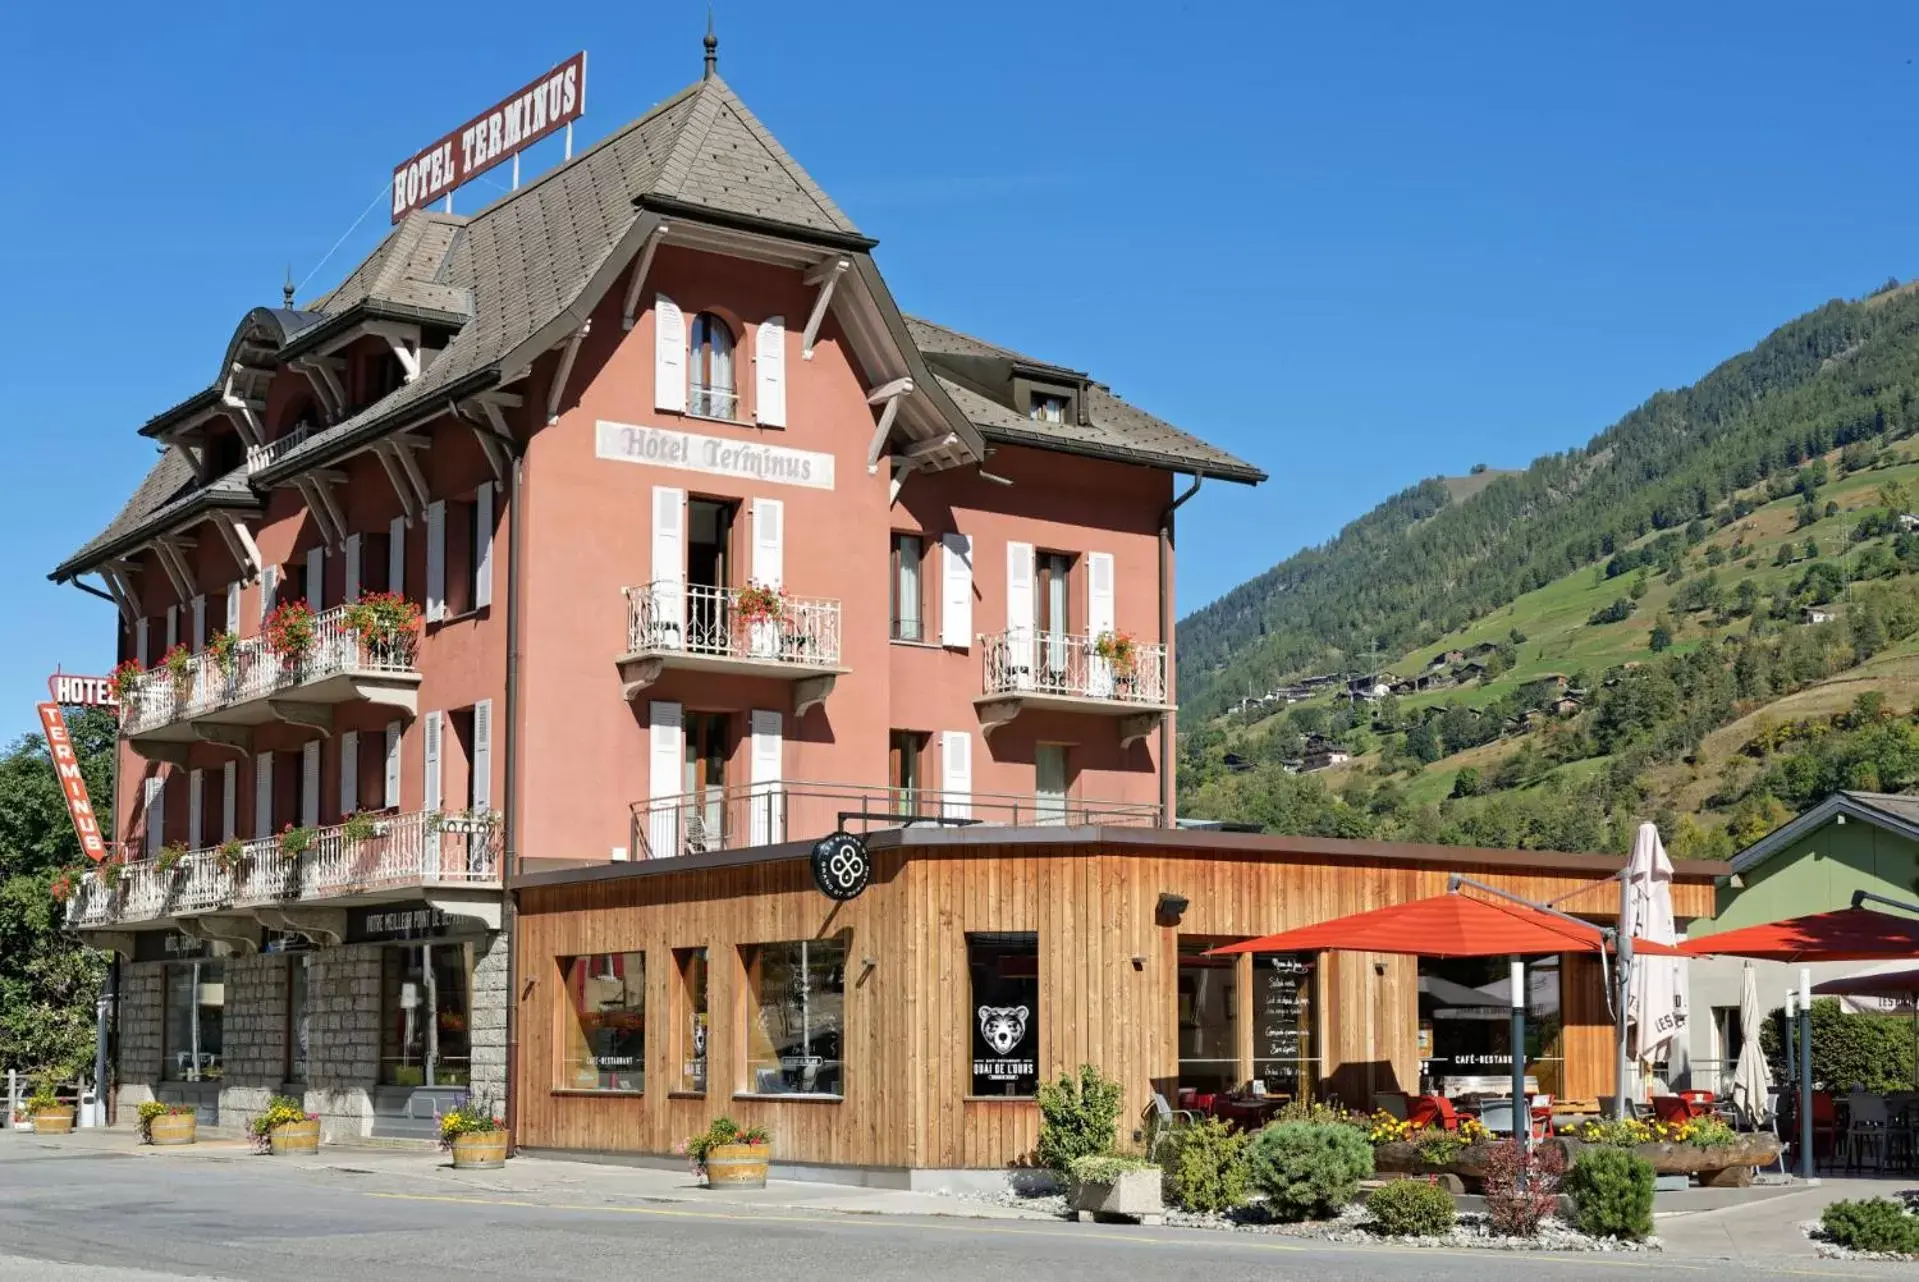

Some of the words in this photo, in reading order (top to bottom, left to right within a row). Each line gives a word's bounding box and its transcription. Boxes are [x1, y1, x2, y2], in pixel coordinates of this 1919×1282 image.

[393, 141, 455, 215] HOTEL
[462, 64, 576, 173] TERMINUS
[620, 427, 689, 463] Hôtel
[703, 438, 811, 480] Terminus
[58, 677, 119, 705] HOTEL
[43, 708, 101, 850] TERMINUS
[995, 1063, 1005, 1074] DE
[1455, 1053, 1527, 1064] CAFÉ-RESTAURT
